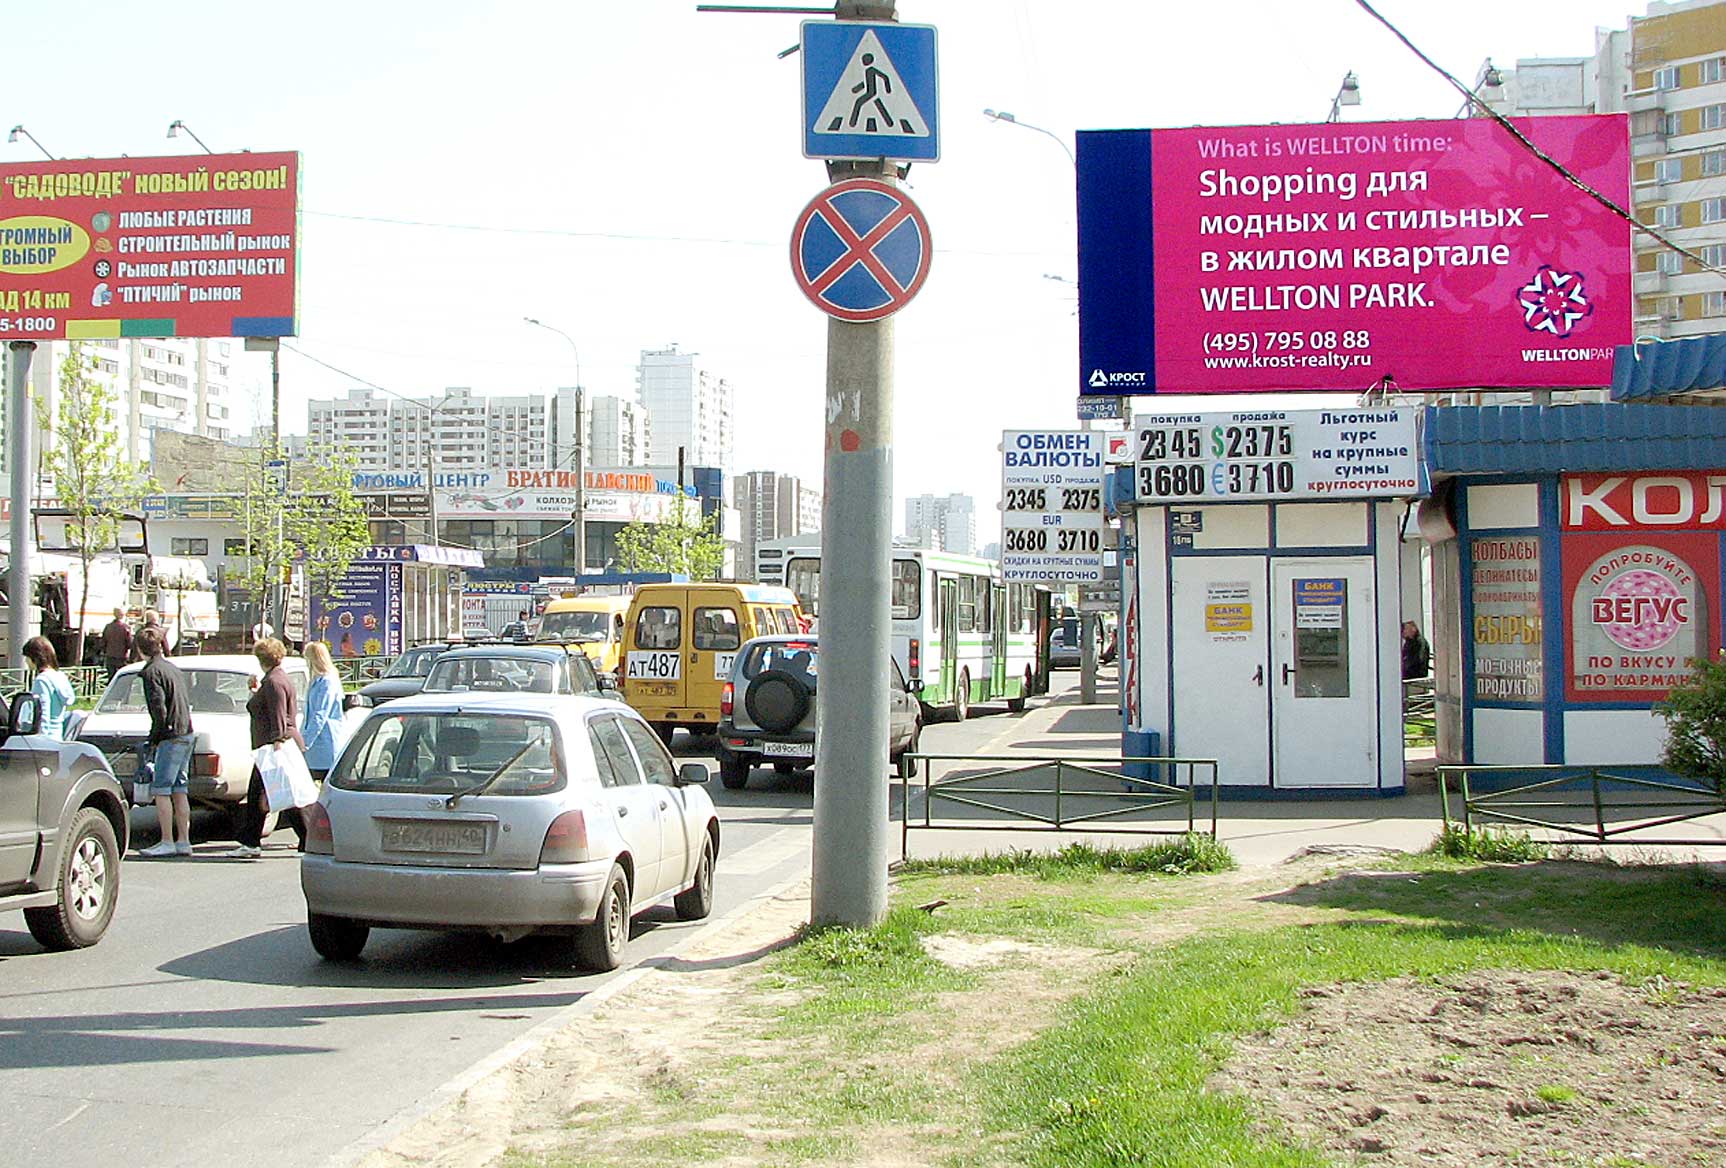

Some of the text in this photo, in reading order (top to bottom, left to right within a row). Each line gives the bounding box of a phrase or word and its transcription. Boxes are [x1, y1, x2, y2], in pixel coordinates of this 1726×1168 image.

[1198, 133, 1452, 158] What is WELLTON time:
[1199, 167, 1428, 201] Shopping для
[118, 209, 252, 228] ЛЮБЫЕ РАСТЕНИЯ
[1200, 212, 1329, 238] модных
[1338, 212, 1356, 230] и
[1365, 207, 1524, 231] стильных
[118, 231, 291, 253] СТРОИТЕЛЬНЫЙ рынок
[2, 248, 57, 265] ВЫБОР
[1201, 244, 1510, 274] в жилом квартале
[170, 258, 285, 277] АВТОЗАПЧАСТИ
[23, 290, 42, 309] 14
[190, 287, 242, 303] рынок
[1200, 282, 1435, 311] WELLTON PARK.
[1203, 330, 1370, 353] (495) 795 08 88
[1204, 351, 1372, 369] www.krost-realty.ru
[1521, 347, 1615, 361] WELLTONPAR
[1109, 372, 1146, 382] КРОСТ
[1151, 411, 1286, 426] покупка продажа
[1320, 410, 1399, 424] Льготный
[1016, 434, 1090, 450] ОБМЕН
[1140, 425, 1292, 461] 2345 $ 2375
[1340, 431, 1377, 443] курс
[1005, 452, 1100, 467] ВАЛЮТЫ
[1312, 447, 1408, 460] на крупные
[351, 472, 422, 489] ОРГОВЫЙ
[1043, 474, 1062, 484] USD
[1140, 461, 1294, 496] 3680 € 3710
[1335, 465, 1389, 478] суммы
[1308, 479, 1415, 492] круглосуточно
[1007, 489, 1100, 511] 2345 2375
[1043, 515, 1062, 525] EUR
[1006, 530, 1099, 552] 3680 3710
[1472, 541, 1537, 561] КОЛБАСЫ
[1004, 570, 1098, 580] КРУГЛОСУТОЧНО
[1590, 553, 1692, 585] ПОПРОБУЙТЕ
[1593, 597, 1688, 625] ВЕГУС
[1475, 615, 1541, 644] СЫРЫ
[1589, 656, 1613, 668] ПО
[1620, 656, 1676, 668] ВКУСУ
[1477, 678, 1539, 698] ПРОДУКТЫ
[1582, 674, 1690, 686] ПО КАРМАН
